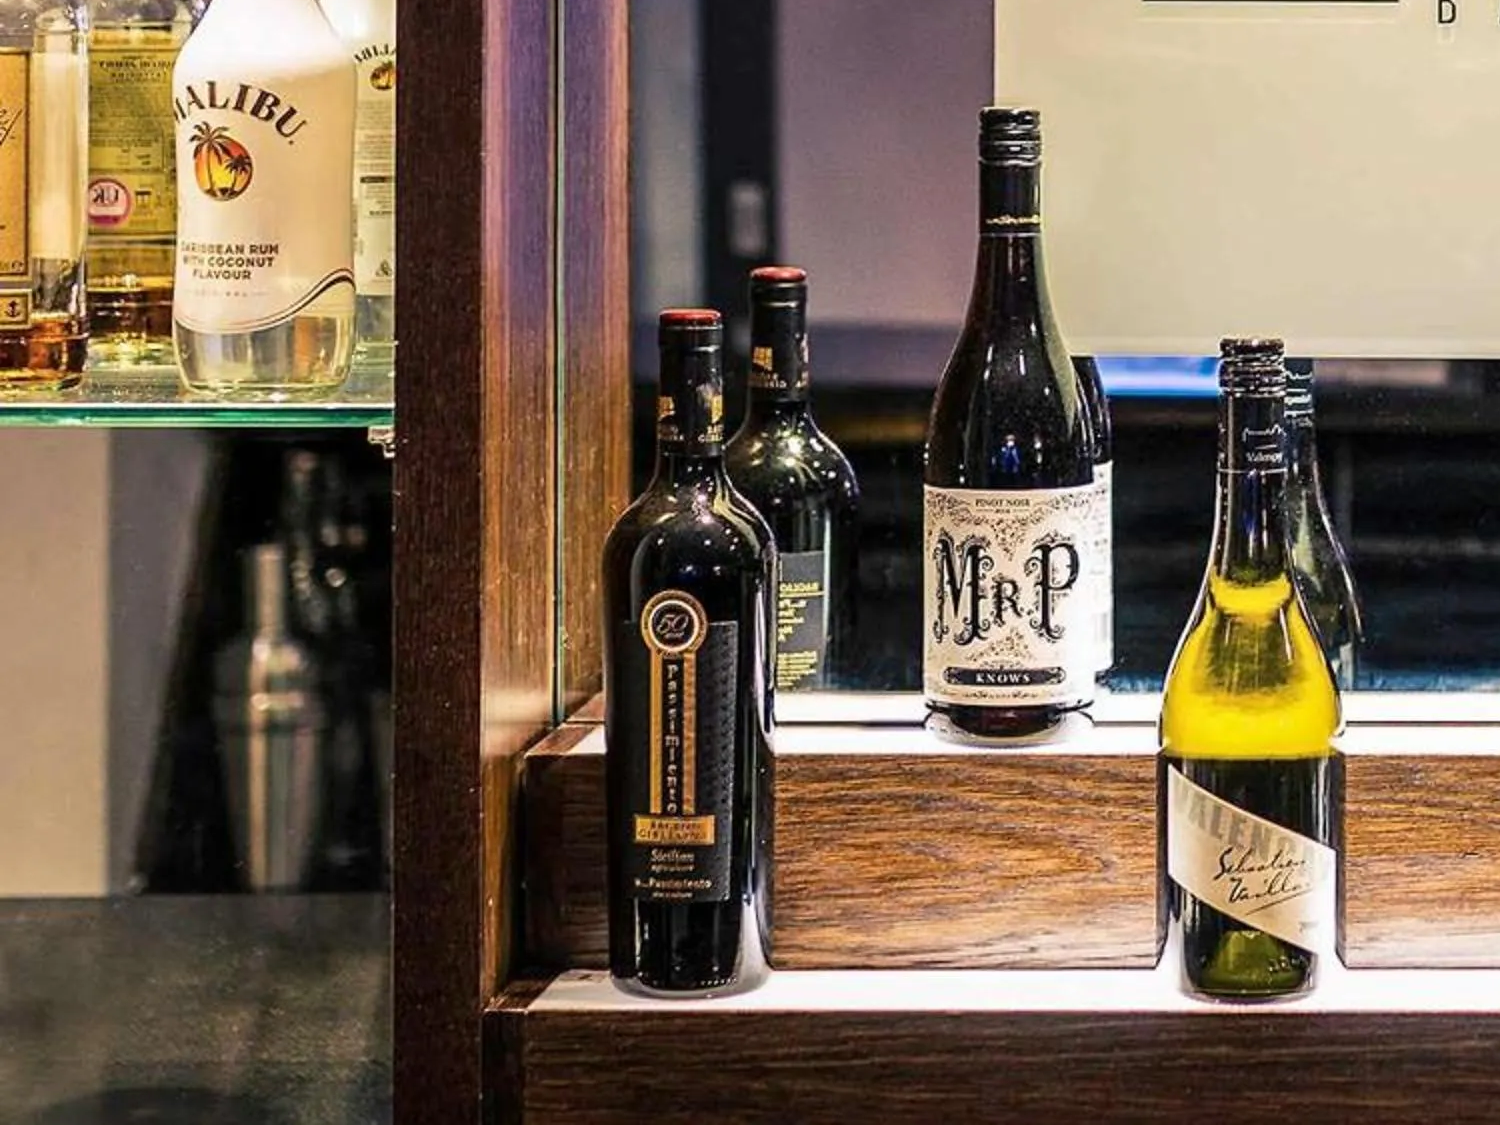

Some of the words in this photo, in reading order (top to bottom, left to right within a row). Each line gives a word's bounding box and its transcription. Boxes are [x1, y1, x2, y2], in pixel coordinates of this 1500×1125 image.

[249, 243, 279, 256] RUM
[207, 256, 276, 268] COCONUT
[192, 268, 253, 280] FLAVOUR
[975, 672, 1032, 685] KNOWS
